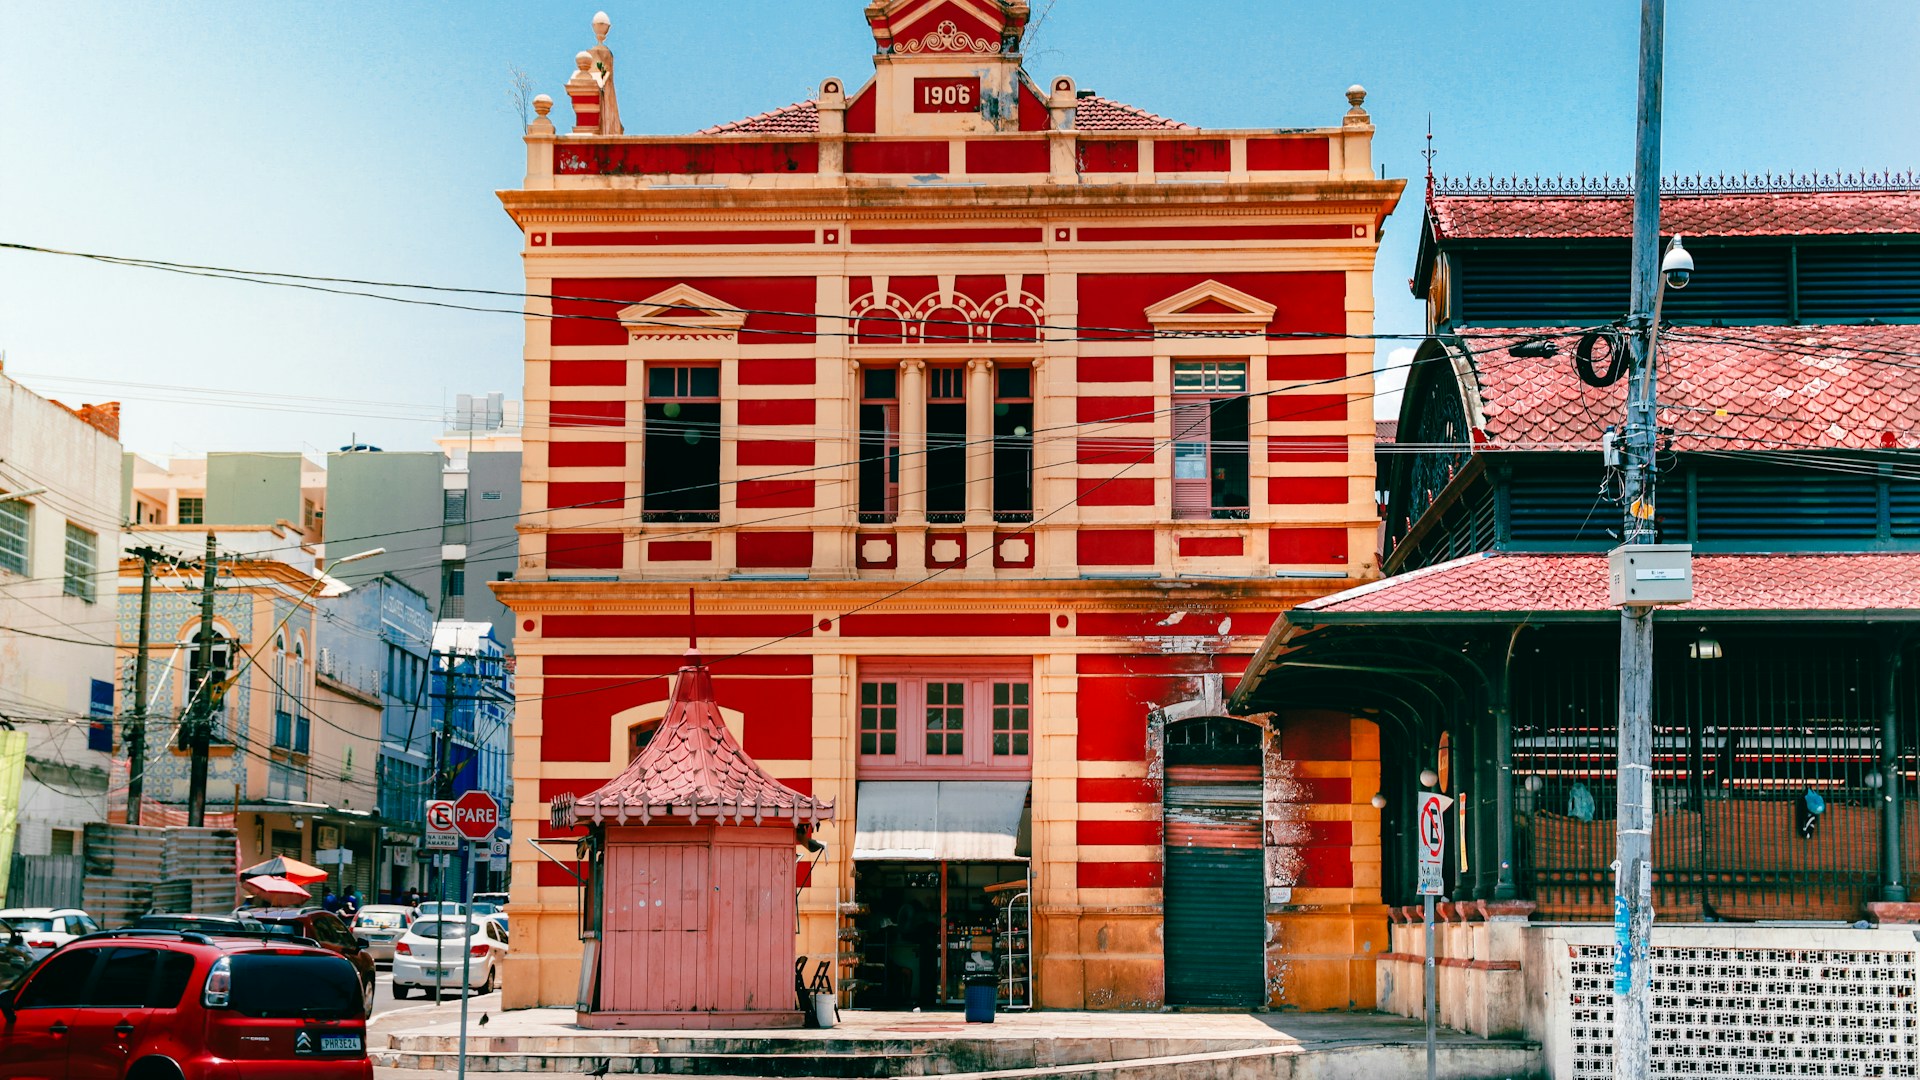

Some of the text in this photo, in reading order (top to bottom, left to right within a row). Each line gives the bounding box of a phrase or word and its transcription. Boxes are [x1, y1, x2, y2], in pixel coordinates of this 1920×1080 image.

[924, 85, 970, 105] 1906
[456, 808, 495, 823] PARE
[325, 1039, 357, 1049] PHR3E24
